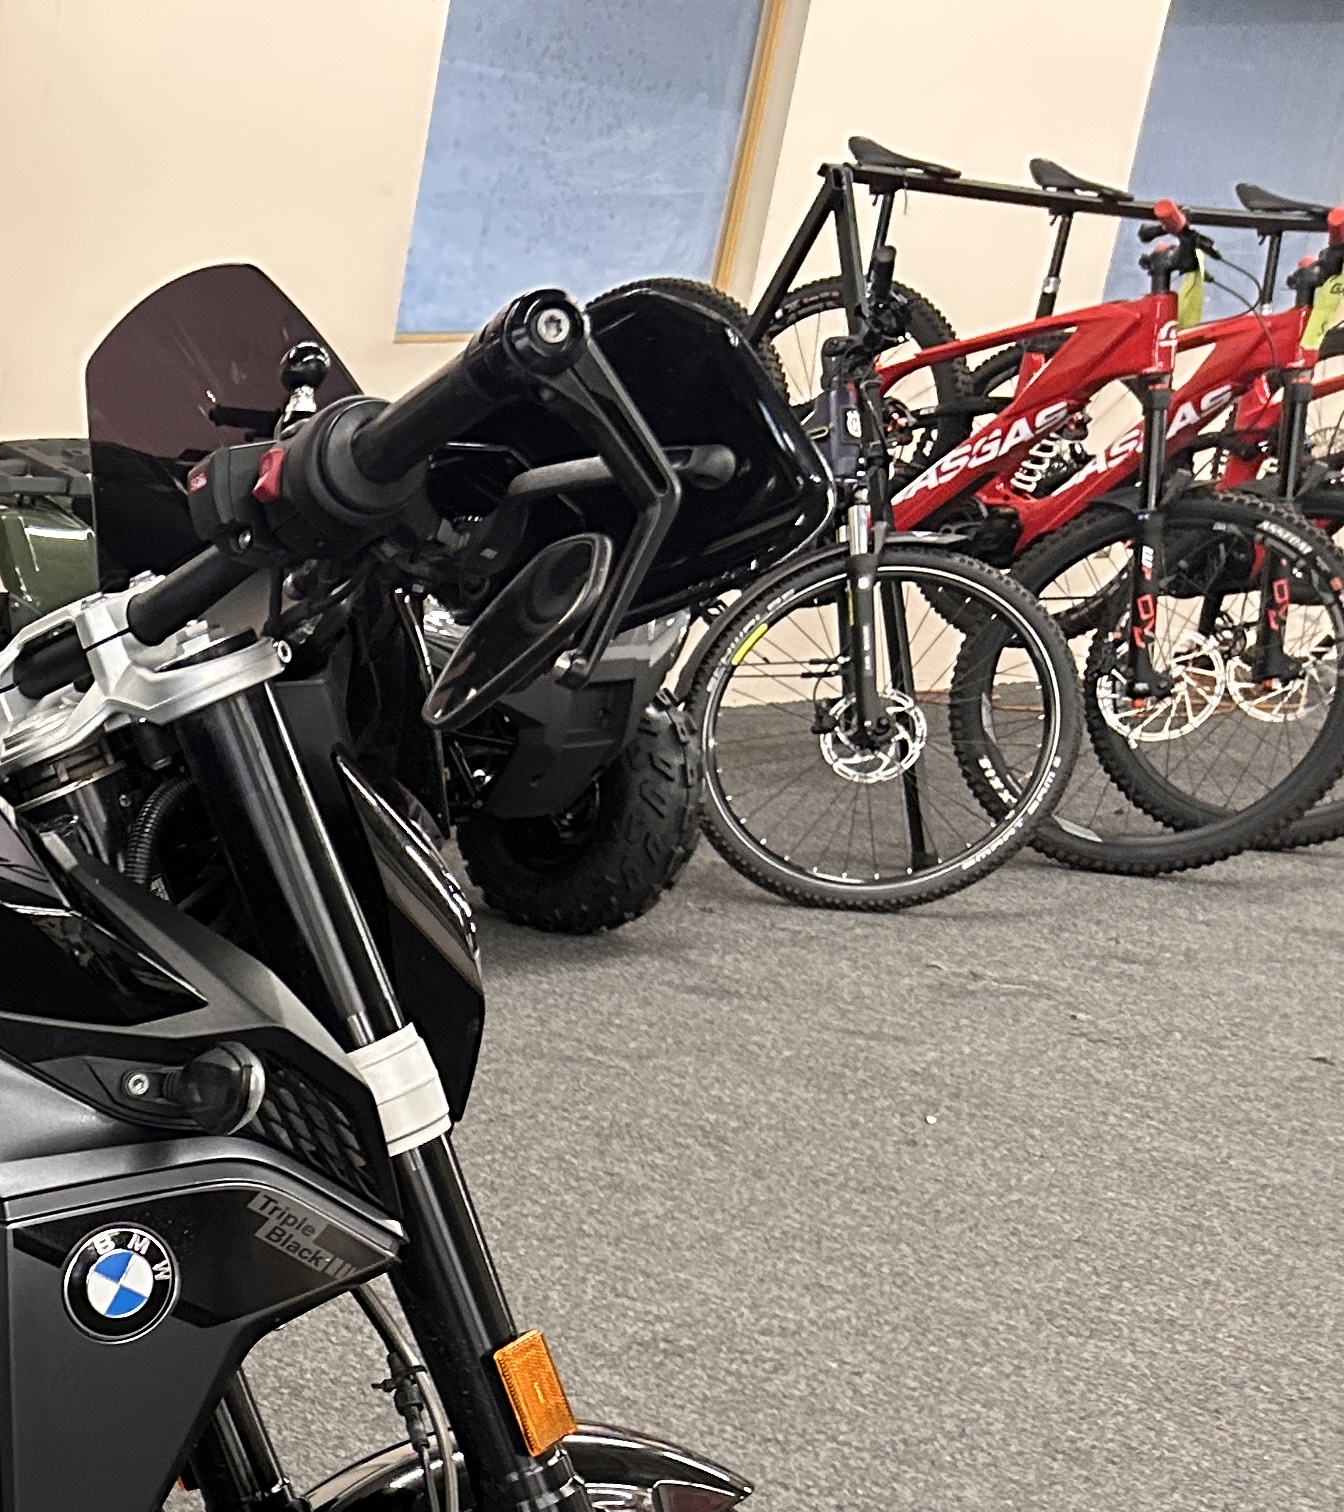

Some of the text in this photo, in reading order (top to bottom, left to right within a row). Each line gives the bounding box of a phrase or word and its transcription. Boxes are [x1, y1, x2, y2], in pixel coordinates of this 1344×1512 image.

[258, 1194, 316, 1237] Triple
[93, 1231, 172, 1281] BMW
[264, 1225, 324, 1268] Black
